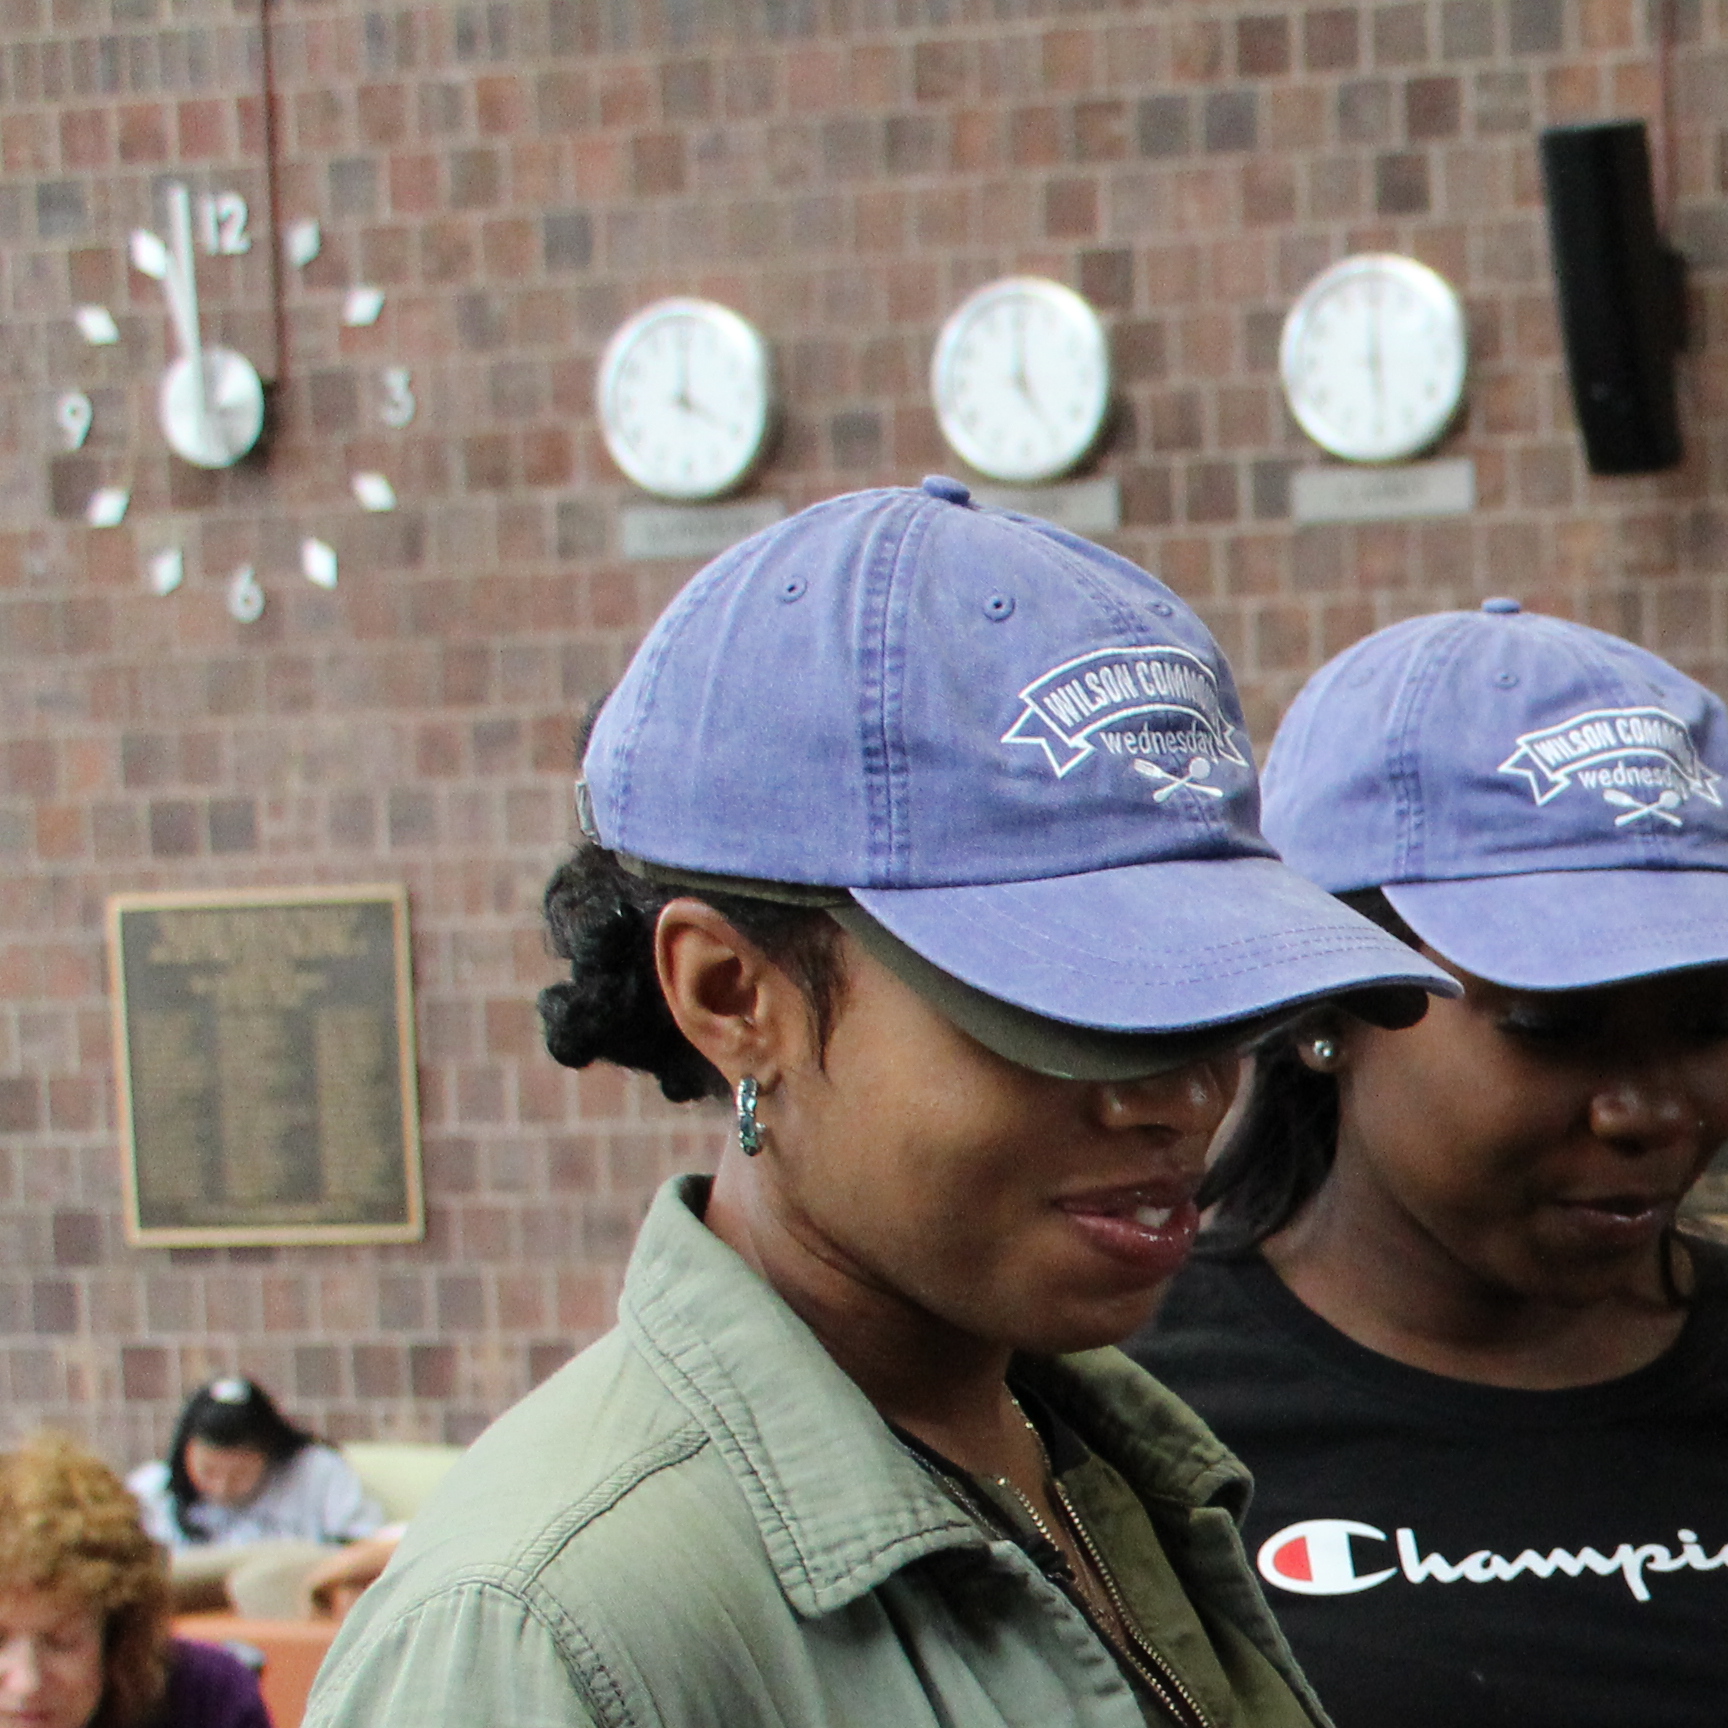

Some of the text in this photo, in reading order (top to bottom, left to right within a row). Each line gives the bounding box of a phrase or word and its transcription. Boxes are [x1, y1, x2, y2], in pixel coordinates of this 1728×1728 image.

[202, 191, 252, 256] 12
[56, 389, 93, 451] 9
[379, 366, 417, 429] 3
[227, 563, 266, 624] 6
[1043, 660, 1220, 728] WILSON COMM
[1099, 720, 1220, 767] wednesday
[1533, 720, 1618, 767] WILSON
[1577, 760, 1690, 801] wednesd
